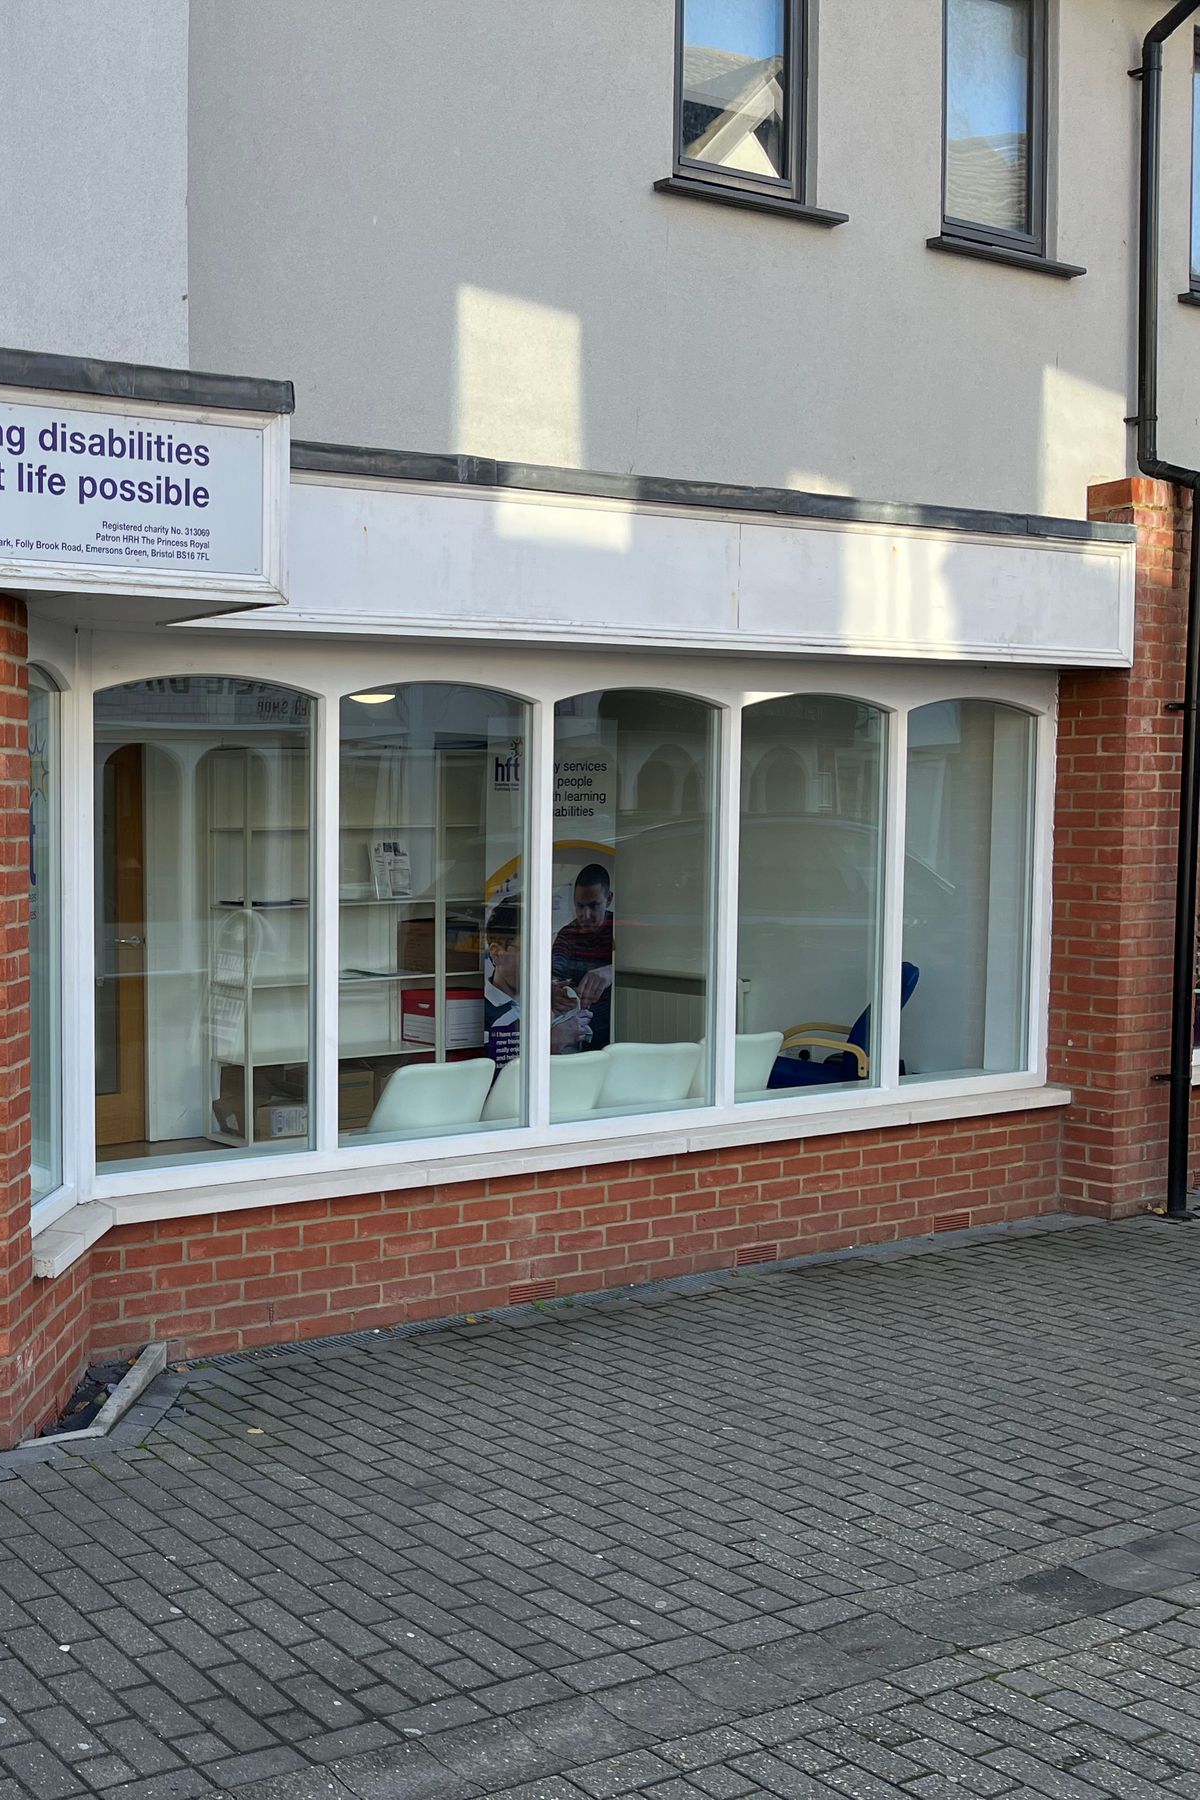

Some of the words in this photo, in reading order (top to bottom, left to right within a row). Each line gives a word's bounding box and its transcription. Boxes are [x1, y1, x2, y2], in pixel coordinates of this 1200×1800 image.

[38, 422, 210, 467] disabilities
[18, 462, 66, 495] life
[79, 475, 210, 508] possible
[102, 521, 142, 532] Registered
[144, 524, 169, 535] charity
[171, 527, 183, 535] No.
[185, 527, 210, 537] 313069
[95, 533, 120, 542] Patron
[122, 535, 139, 544] HRH
[141, 536, 155, 545] The
[157, 537, 188, 548] Princess
[190, 540, 210, 550] Royal
[16, 539, 34, 550] Folly
[36, 540, 59, 550] Brook
[61, 542, 84, 553] Road,
[85, 544, 123, 555] Emersons
[125, 547, 149, 558] Green,
[151, 549, 174, 559] Bristol
[176, 551, 195, 560] BS16
[196, 552, 210, 561] 7FL
[494, 757, 520, 782] hft
[563, 761, 608, 772] services
[557, 775, 593, 789] people
[564, 790, 607, 804] learning
[552, 806, 594, 817] abilities
